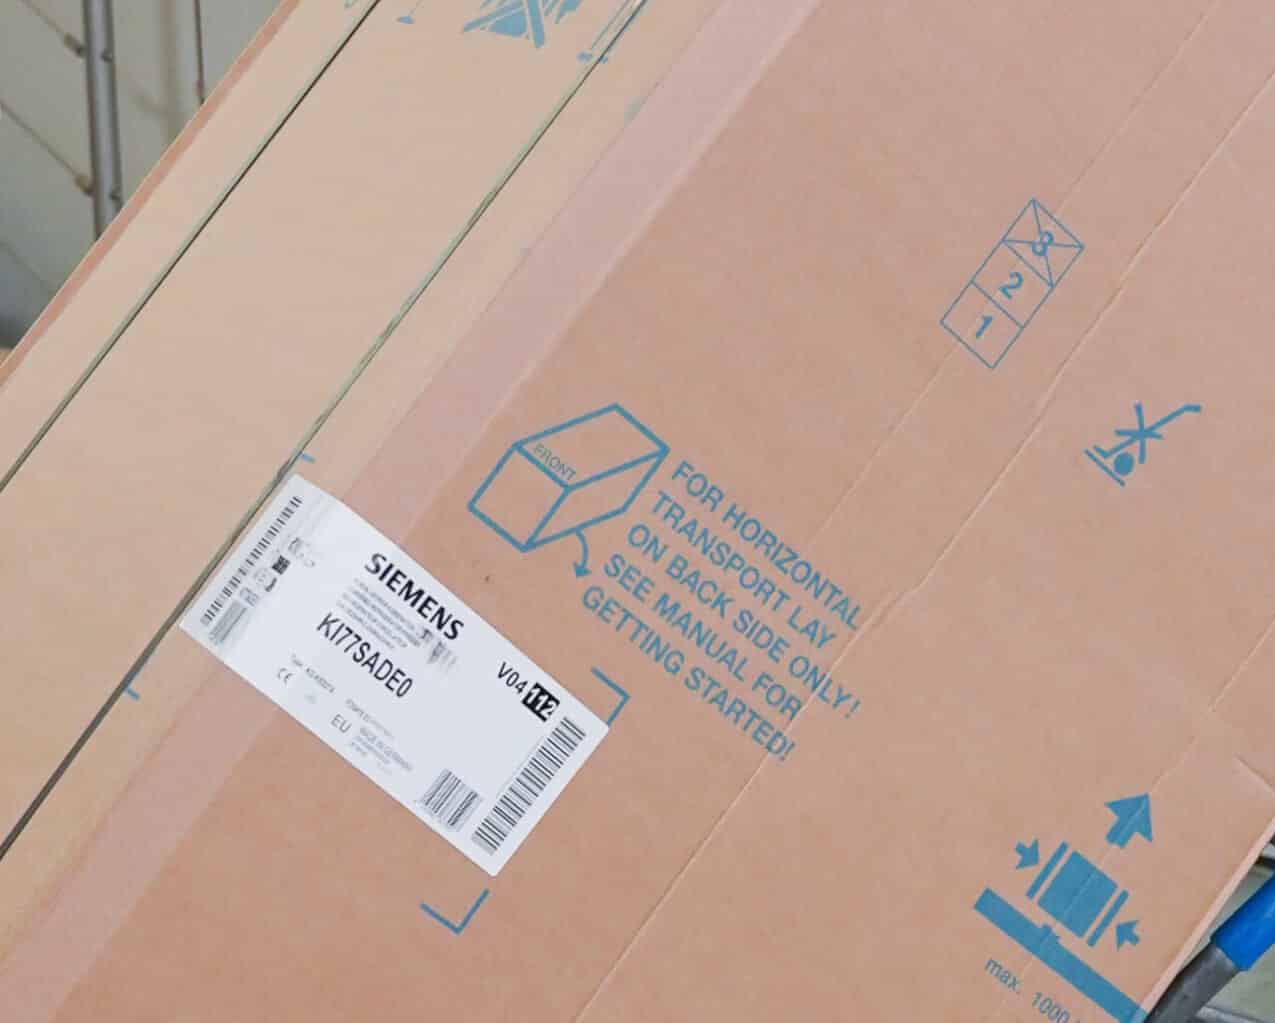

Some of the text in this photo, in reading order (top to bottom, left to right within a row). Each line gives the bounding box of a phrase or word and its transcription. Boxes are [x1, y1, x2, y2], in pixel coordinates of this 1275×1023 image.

[976, 315, 994, 339] 1
[999, 271, 1025, 300] 2
[533, 443, 576, 481] FRONT
[652, 490, 837, 650] TRANSPORT LAY
[671, 460, 862, 631] FOR HORIZONTAL
[364, 552, 464, 640] SIEMENS
[603, 552, 803, 722] SEE MANUAL FOR
[627, 523, 862, 720] ON BACK SIDE ONLY!
[316, 611, 413, 698] KI77SADE0
[497, 661, 529, 695] V04
[582, 585, 797, 762] GETTING STARTED!
[330, 713, 352, 734] EU
[1031, 991, 1071, 1023] 1000
